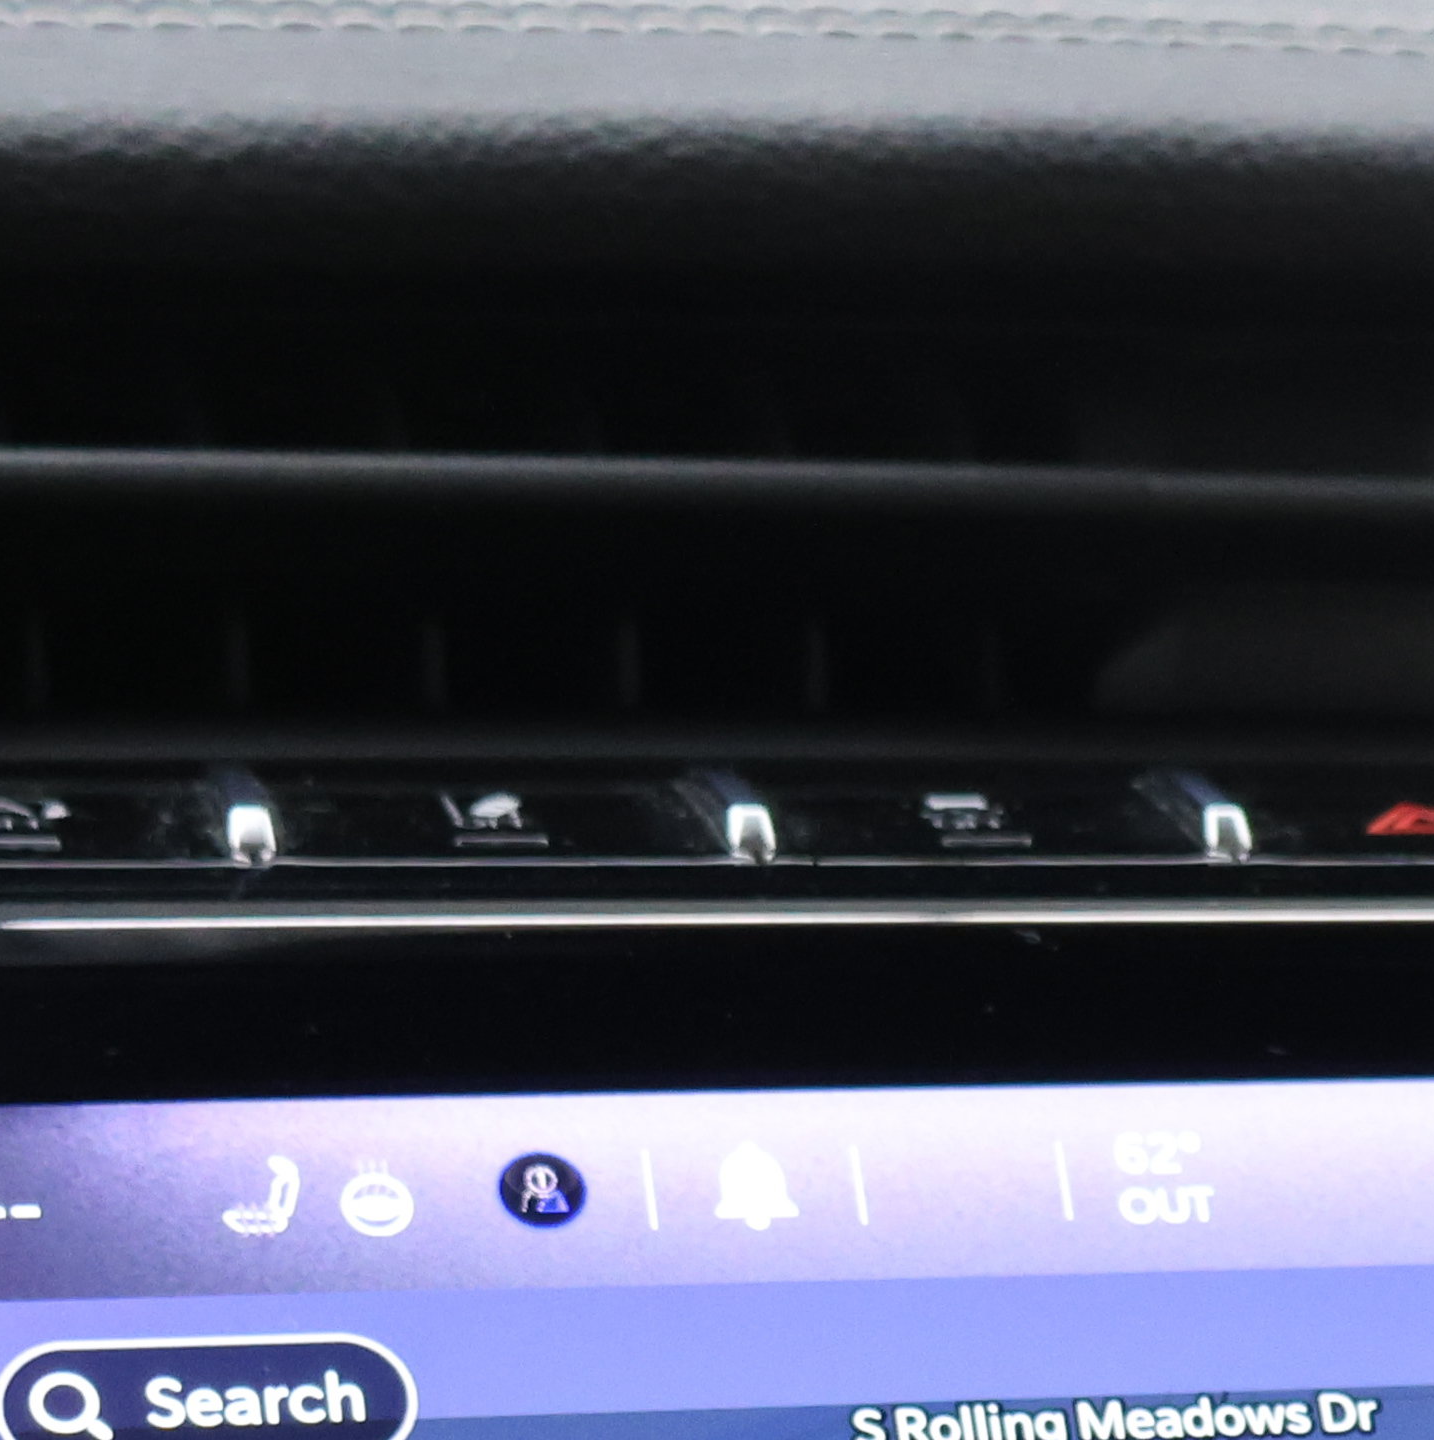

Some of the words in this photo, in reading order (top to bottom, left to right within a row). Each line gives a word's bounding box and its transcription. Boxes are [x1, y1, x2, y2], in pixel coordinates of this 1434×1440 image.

[1118, 1185, 1214, 1225] OUT
[143, 1370, 368, 1431] Search
[1316, 1392, 1377, 1434] Dr
